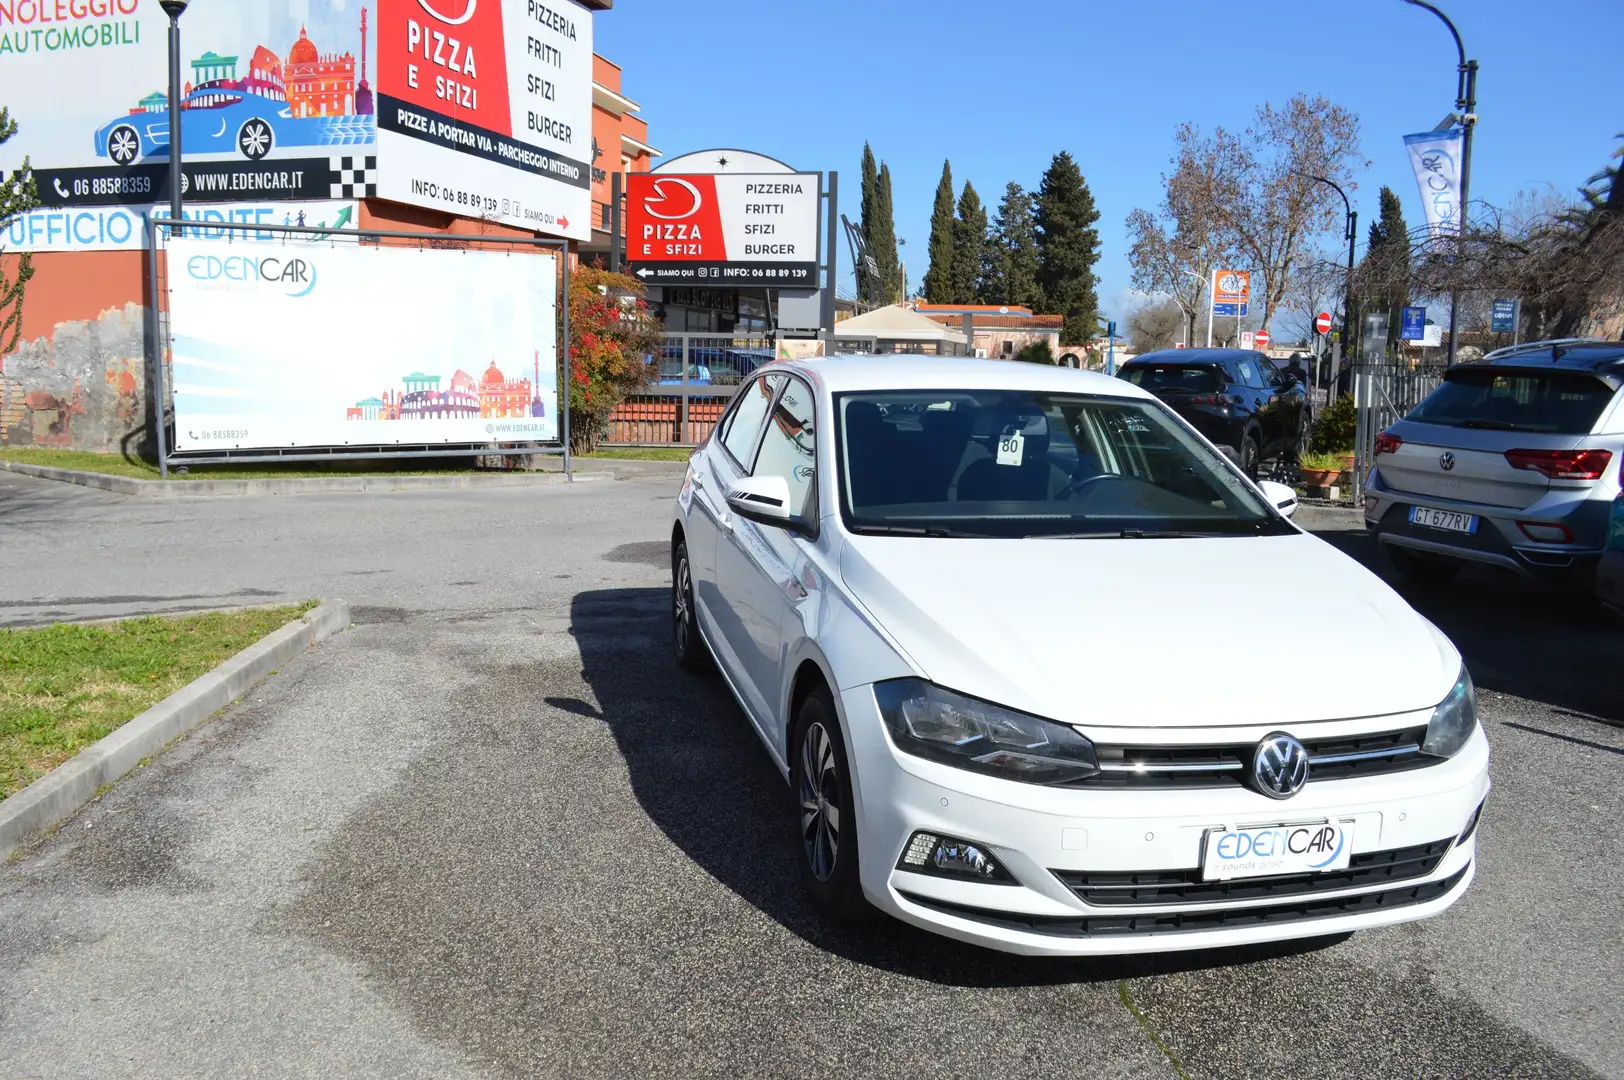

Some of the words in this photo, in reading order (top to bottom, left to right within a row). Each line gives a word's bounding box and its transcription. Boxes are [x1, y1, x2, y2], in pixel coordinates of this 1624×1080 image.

[0, 0, 138, 25] NOLEGGIO
[528, 0, 577, 42] PIZZERIA
[0, 20, 139, 55] AUTOMOBILI
[407, 19, 477, 79] PIZZA
[528, 36, 561, 69] FRITTI
[407, 64, 419, 89] E
[435, 75, 477, 110] SFIZI
[527, 73, 555, 102] SFIZI
[527, 110, 572, 144] BURGER
[397, 109, 427, 133] PIZZE
[429, 119, 437, 136] A
[438, 122, 476, 147] PORTAR
[477, 135, 493, 153] VIA
[498, 142, 549, 170] PARCHEGGIO
[549, 159, 580, 180] INTERNO
[74, 179, 89, 195] 06
[93, 176, 151, 195] 88588359
[194, 171, 304, 191] WWW.EDENCAR.IT
[745, 184, 803, 195] PIZZERIA
[411, 178, 440, 199] INFO:
[443, 188, 455, 202] 06
[457, 191, 468, 205] 88
[471, 194, 481, 208] 89
[484, 197, 498, 212] 139
[524, 208, 544, 223] SIAMO
[545, 213, 555, 225] QUI
[745, 204, 784, 214] FRITTI
[9, 211, 132, 246] UFFICIO
[642, 224, 702, 240] PIZZA
[744, 224, 775, 235] SFIZI
[643, 244, 652, 255] E
[665, 244, 702, 255] SFIZI
[744, 244, 795, 255] BURGER
[187, 255, 308, 283] EDENCAR
[657, 269, 680, 277] SIAMO
[681, 269, 694, 277] QUI
[723, 268, 750, 277] INFO:
[752, 268, 764, 277] 06
[766, 269, 777, 277] 88
[779, 269, 790, 277] 89
[792, 269, 807, 278] 139
[201, 430, 211, 440] 06
[213, 429, 249, 439] 88588359
[495, 423, 545, 432] WWW.EDENCAR.IT
[1002, 439, 1018, 453] 80
[1415, 508, 1430, 523] GT
[1432, 511, 1471, 530] 677RV
[1216, 827, 1335, 859] EDENCAR
[1222, 861, 1256, 871] sounds
